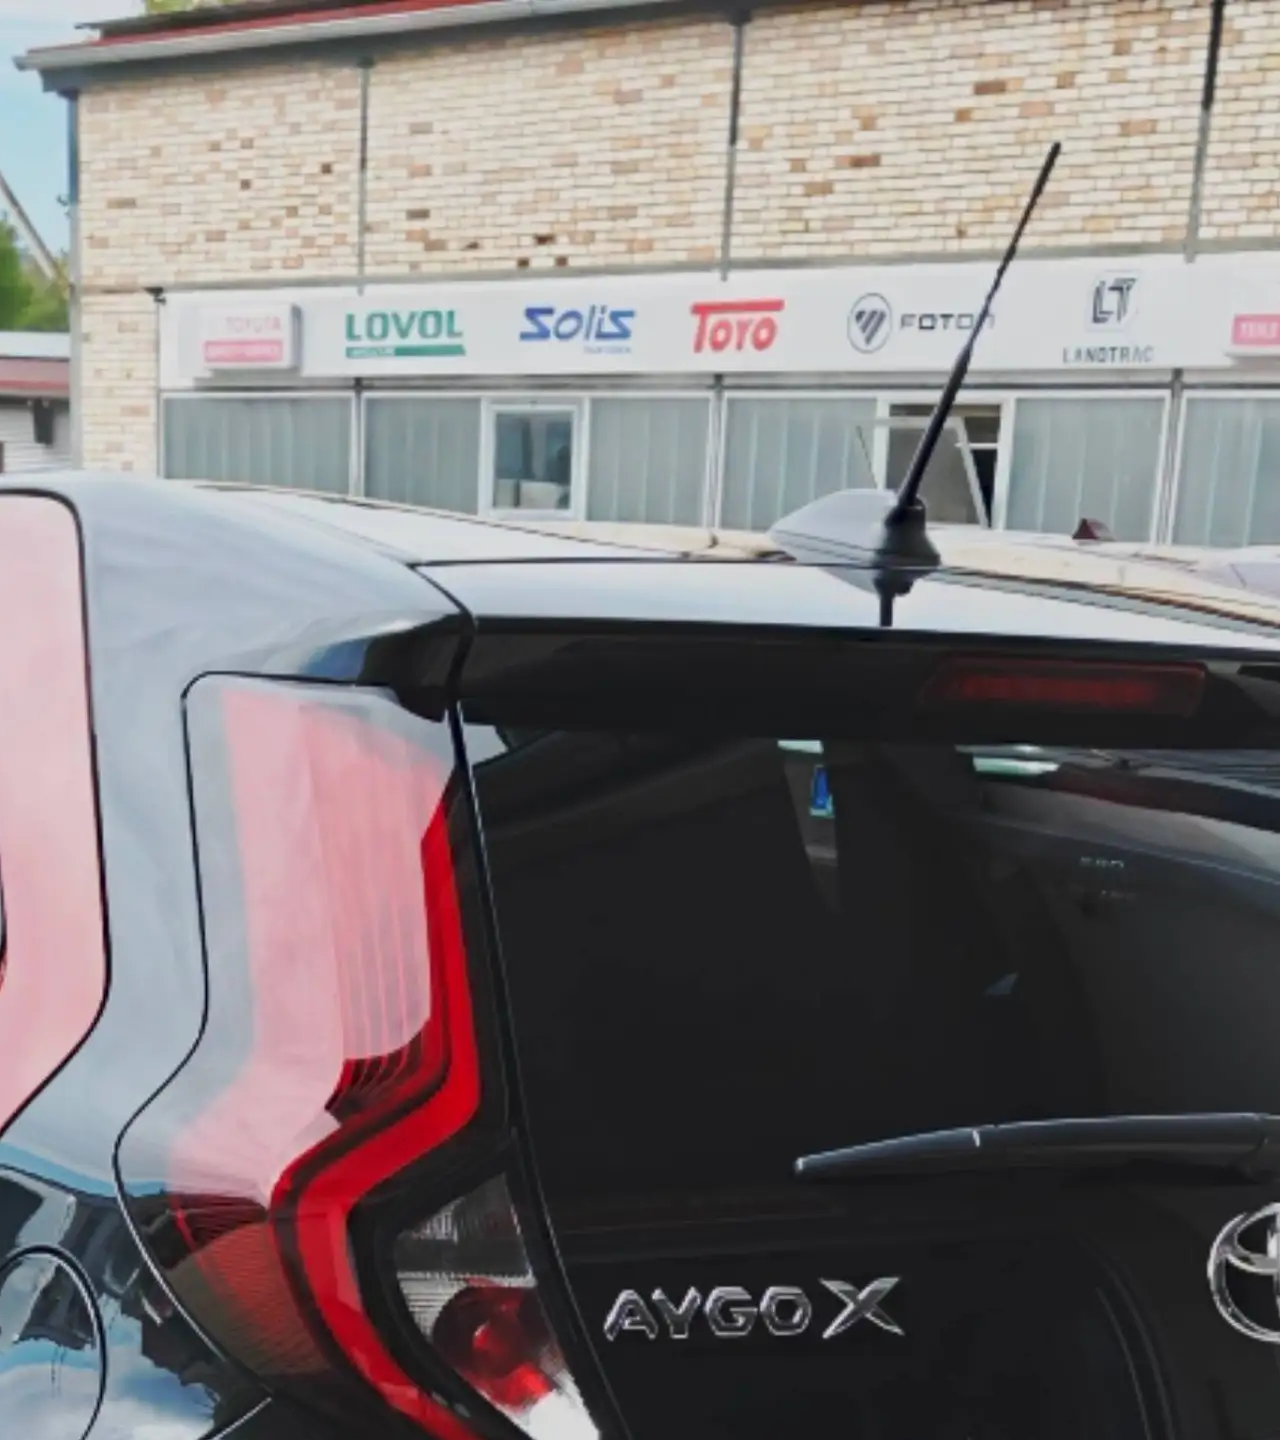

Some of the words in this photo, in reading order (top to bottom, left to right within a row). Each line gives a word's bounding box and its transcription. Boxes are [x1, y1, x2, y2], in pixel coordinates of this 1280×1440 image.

[345, 310, 463, 341] LOVOL
[603, 1286, 812, 1341] AYGO
[819, 1277, 905, 1339] X
